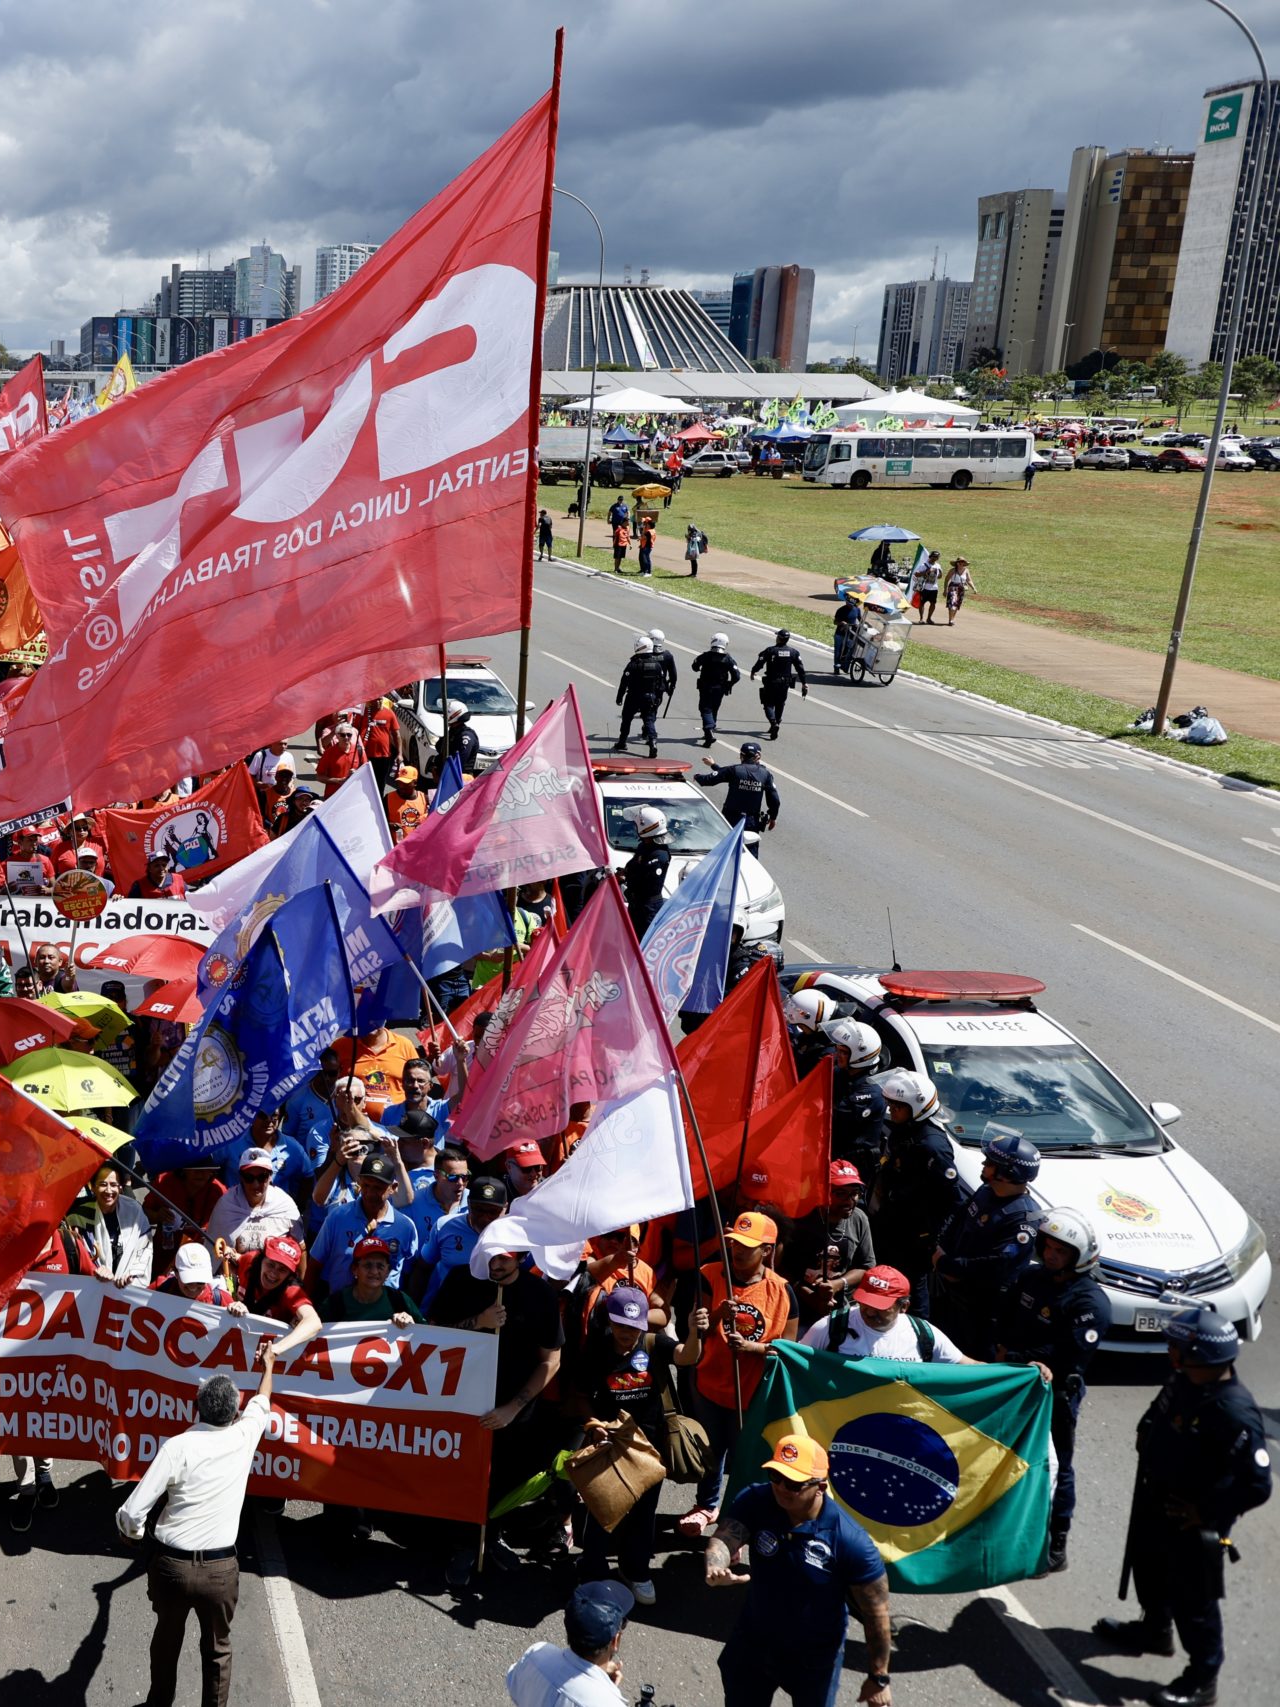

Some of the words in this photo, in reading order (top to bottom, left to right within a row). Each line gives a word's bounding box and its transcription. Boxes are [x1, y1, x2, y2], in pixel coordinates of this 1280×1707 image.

[1210, 122, 1230, 133] INCRA
[739, 778, 762, 787] POLÍCIA
[63, 899, 103, 912] ESCALA
[150, 1003, 175, 1014] CUT
[14, 1033, 47, 1051] CUT
[247, 1060, 269, 1107] MAUÁ
[243, 1106, 257, 1119] E
[203, 1112, 250, 1147] ANDRÉ
[1107, 1231, 1151, 1241] POLÍCIA
[1152, 1231, 1195, 1242] MILITAR
[1, 1289, 85, 1341] DA
[350, 1335, 467, 1396] 6X1
[94, 1381, 119, 1417] DA
[265, 1412, 300, 1444] DE
[307, 1414, 462, 1460] TRABALHO!
[27, 1412, 132, 1462] REDUÇÃO
